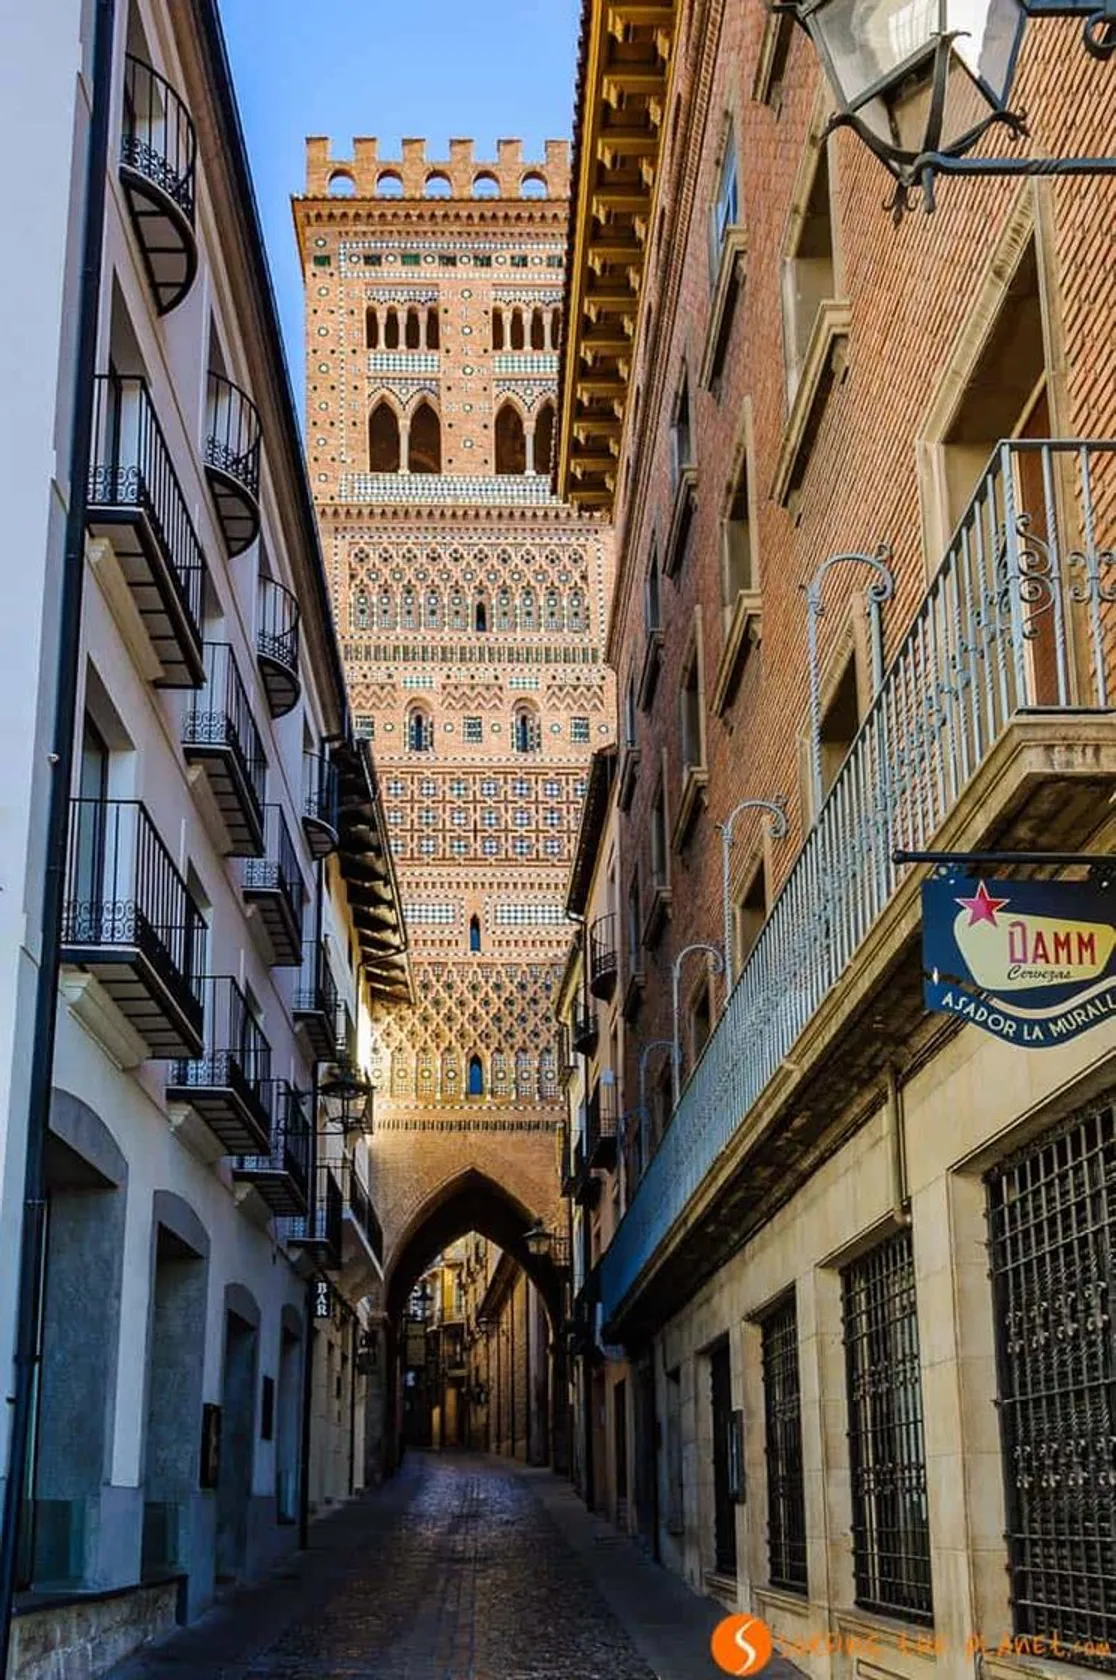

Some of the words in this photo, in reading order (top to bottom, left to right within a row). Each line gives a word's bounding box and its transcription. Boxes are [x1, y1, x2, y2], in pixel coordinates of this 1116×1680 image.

[1008, 920, 1097, 966] DAMM
[1007, 965, 1072, 982] Cervezas
[942, 991, 1017, 1037] ASADOR
[1023, 1025, 1044, 1041] LA
[316, 1282, 328, 1316] BAR
